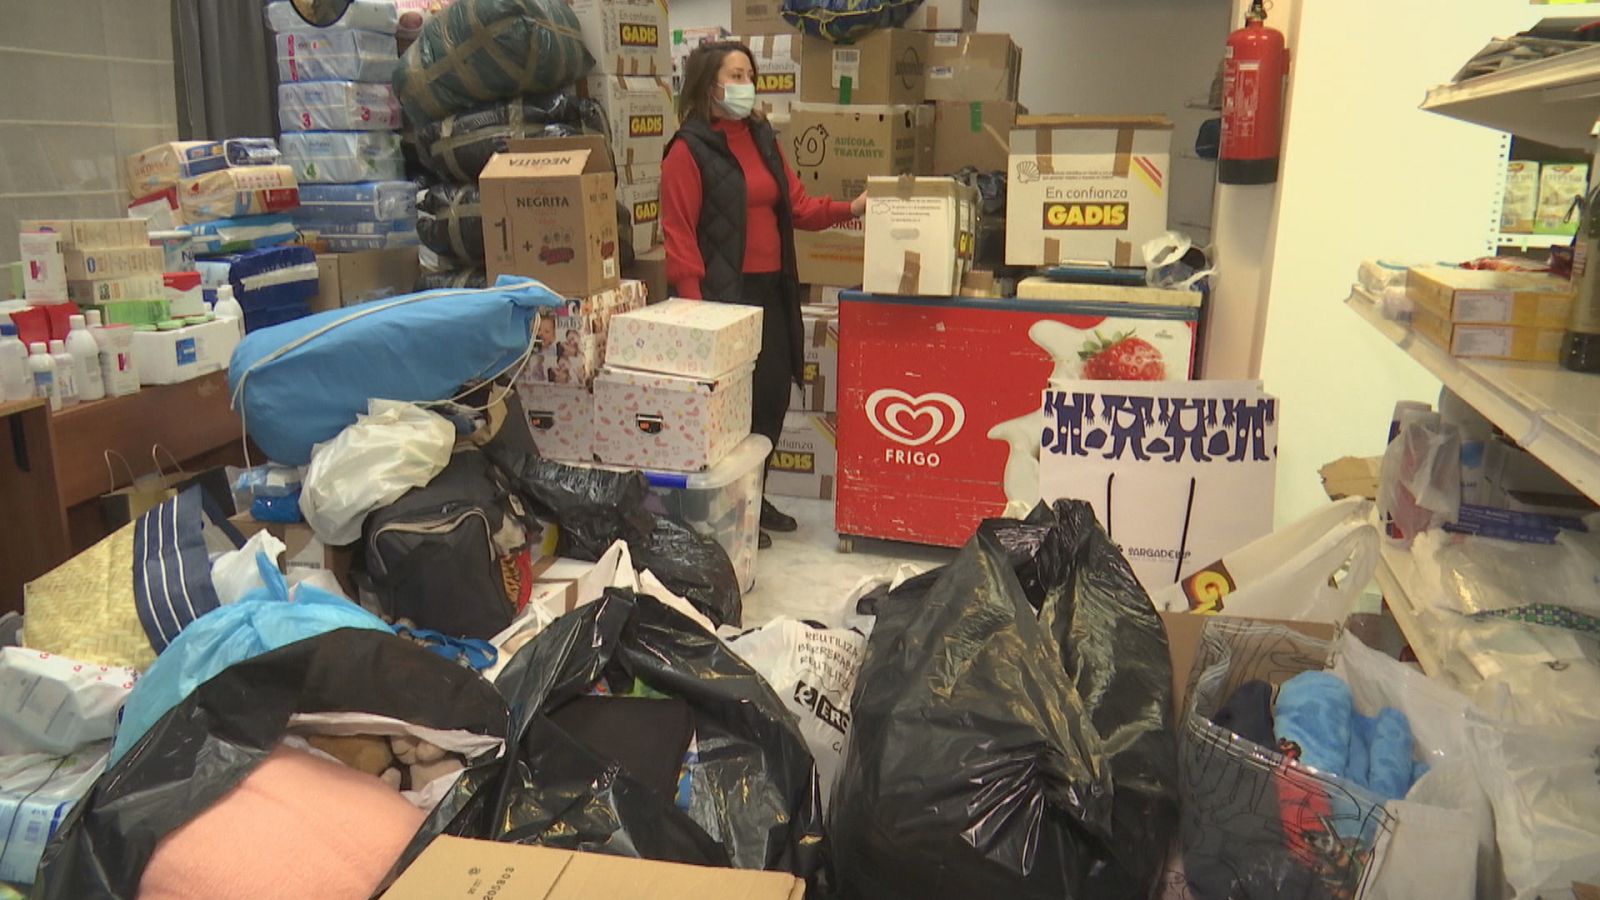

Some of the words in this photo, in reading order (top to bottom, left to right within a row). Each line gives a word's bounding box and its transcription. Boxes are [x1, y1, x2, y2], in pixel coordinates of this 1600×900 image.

[622, 25, 657, 43] GADIS
[757, 62, 795, 71] onfianza
[756, 74, 794, 90] ADIS
[631, 116, 662, 134] GADIS
[509, 157, 572, 168] NEGRITA
[1046, 187, 1063, 199] En
[1066, 186, 1128, 199] confianza
[516, 196, 570, 208] NEGRITA
[635, 203, 658, 219] GAD
[1047, 204, 1126, 226] GADIS
[770, 453, 813, 469] ADIS
[885, 449, 940, 467] FRIGO
